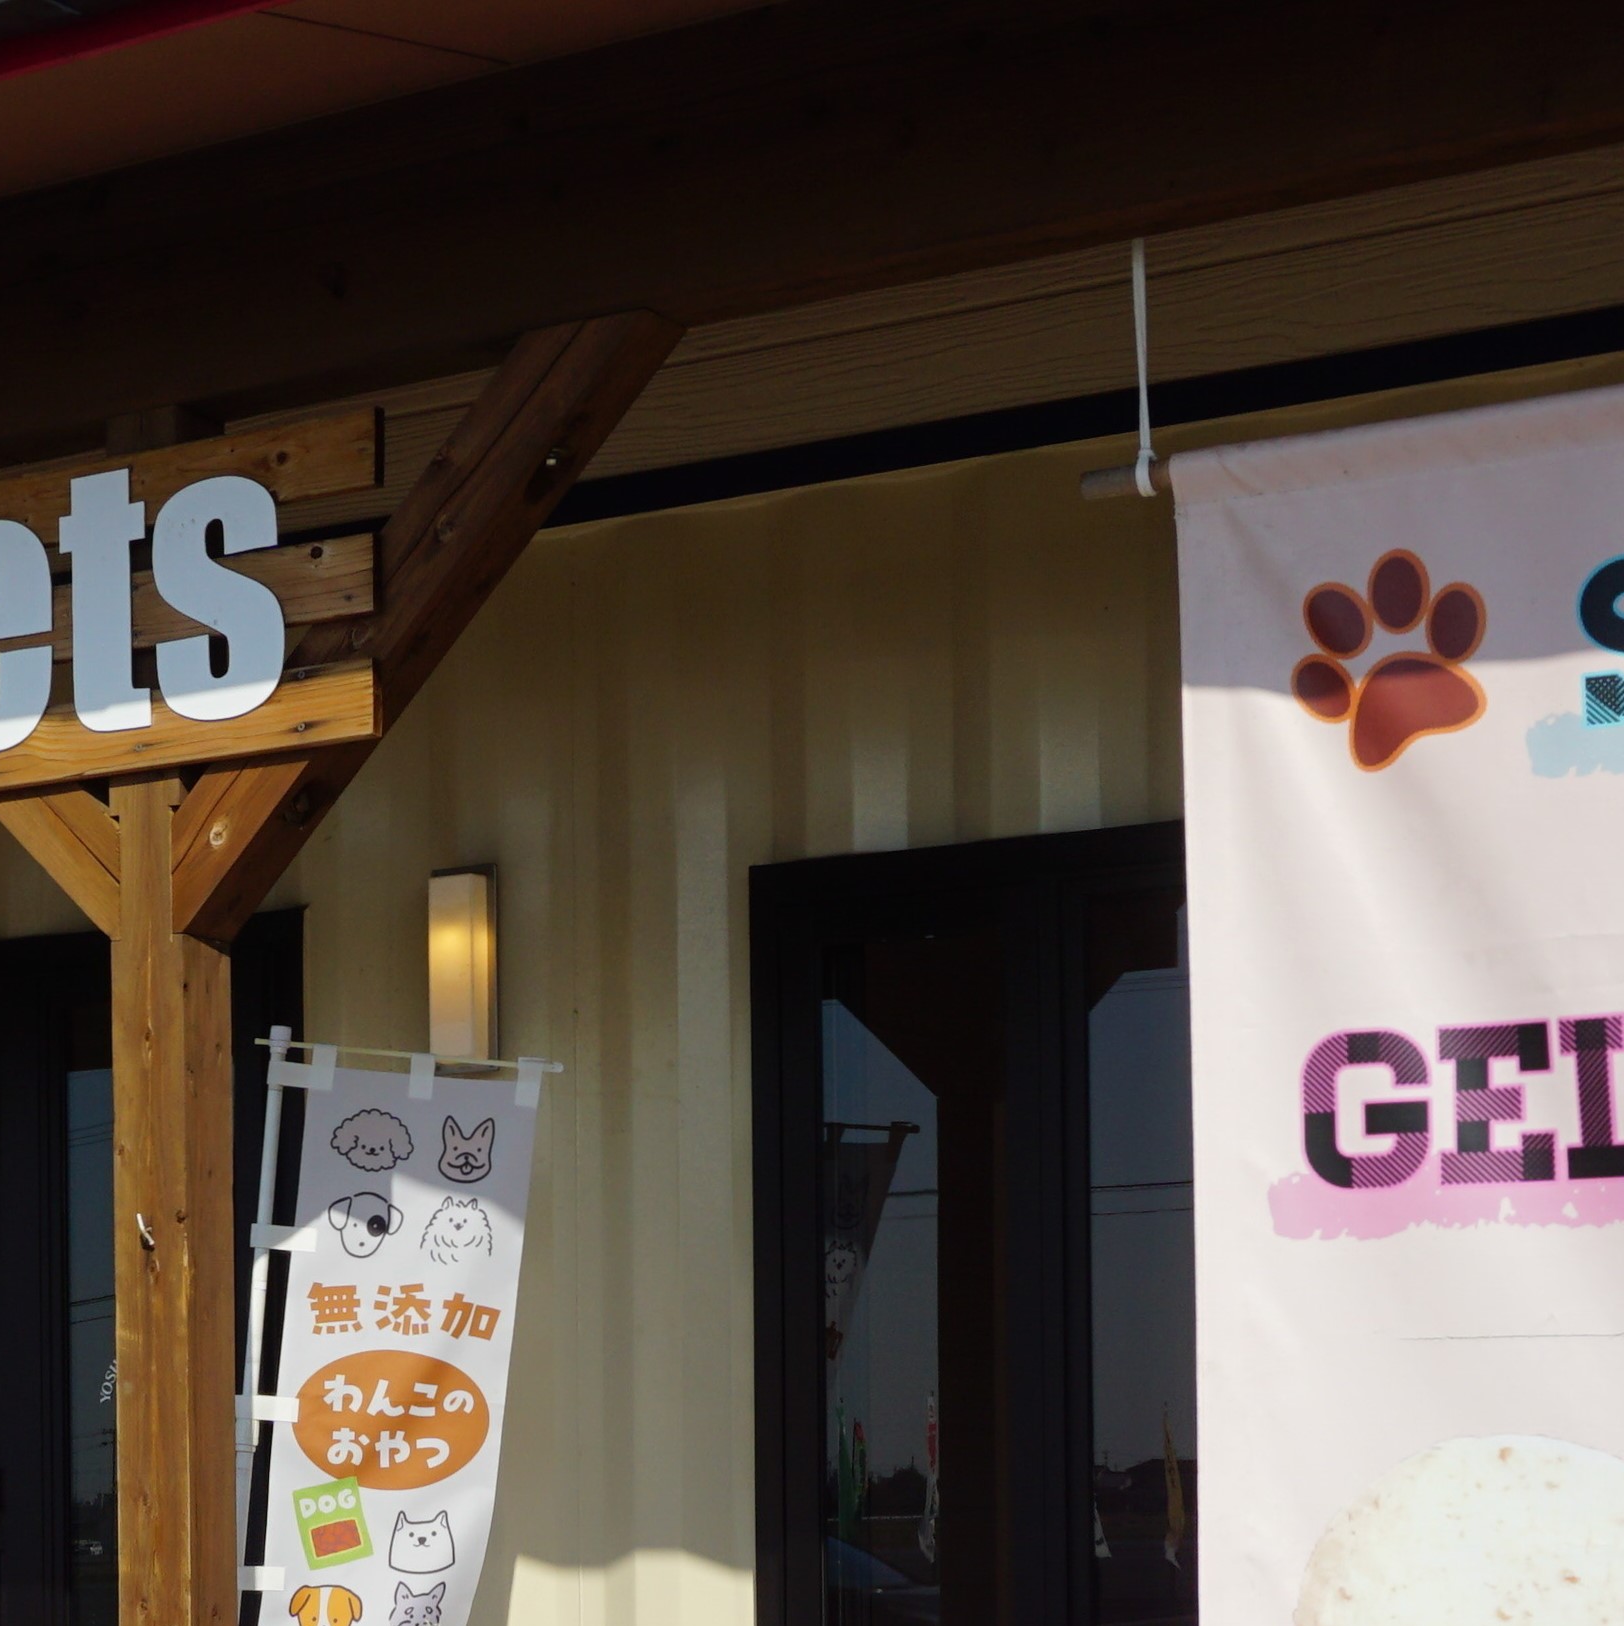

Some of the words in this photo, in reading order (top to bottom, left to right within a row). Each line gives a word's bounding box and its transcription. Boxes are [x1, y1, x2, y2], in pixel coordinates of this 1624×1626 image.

[307, 1282, 501, 1341] 無添加
[323, 1374, 475, 1417] わんこの
[327, 1427, 450, 1468] おやつ
[299, 1488, 357, 1520] DOG
